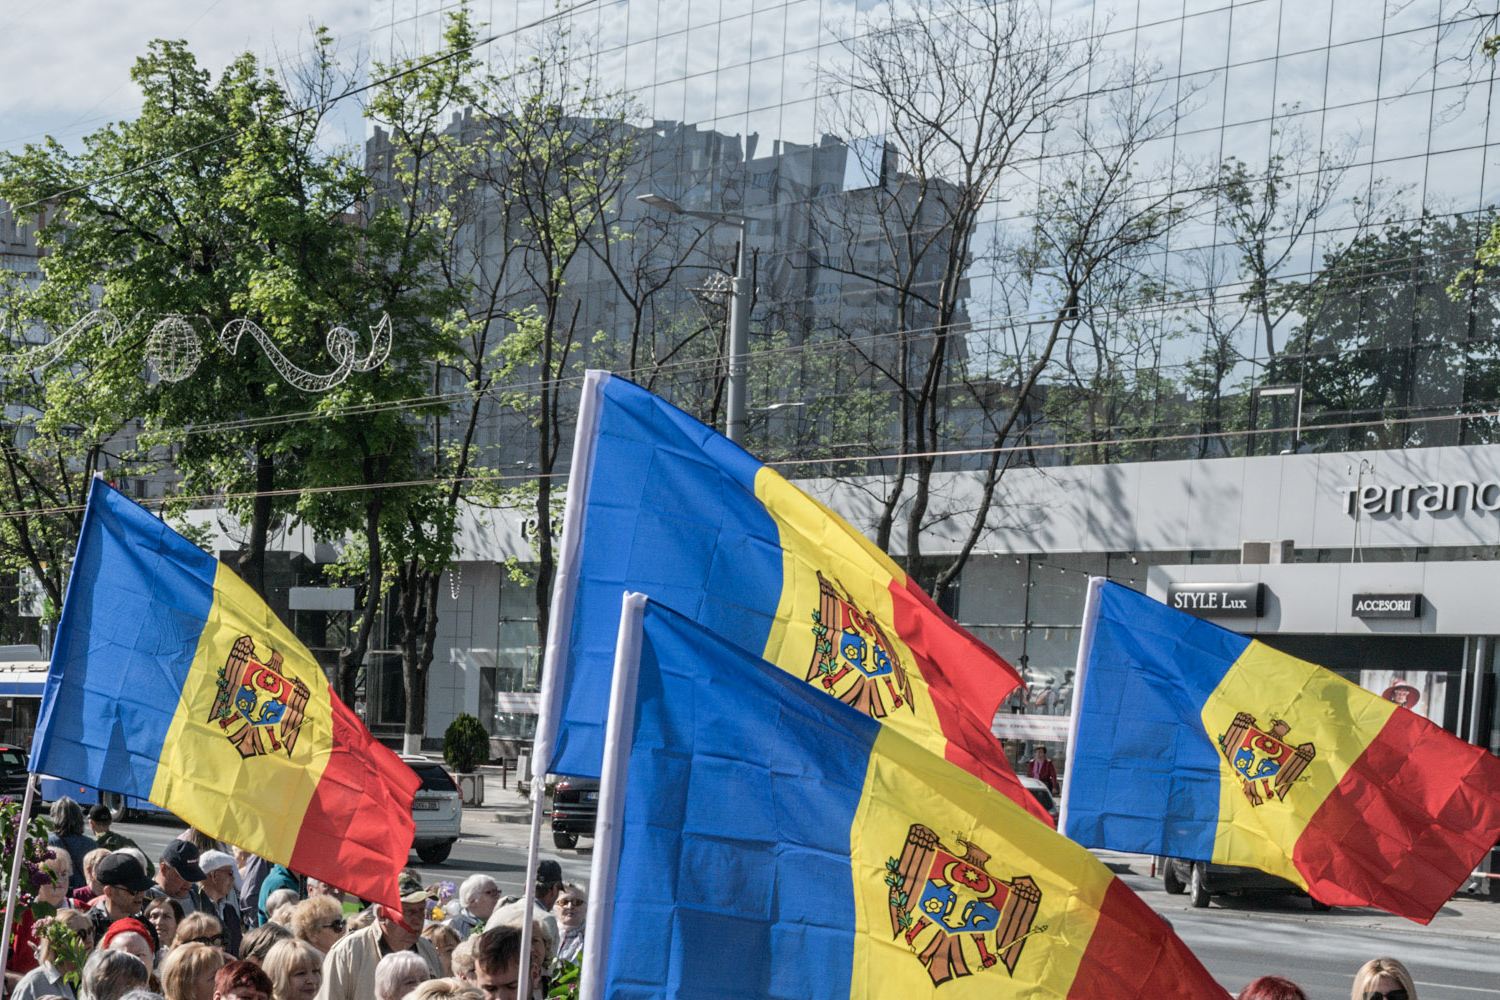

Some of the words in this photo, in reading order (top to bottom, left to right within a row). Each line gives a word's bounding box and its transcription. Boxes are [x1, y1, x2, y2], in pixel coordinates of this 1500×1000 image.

[1174, 592, 1217, 609] STYLE
[1221, 592, 1247, 609] Lux
[1355, 600, 1411, 612] ACCESORII
